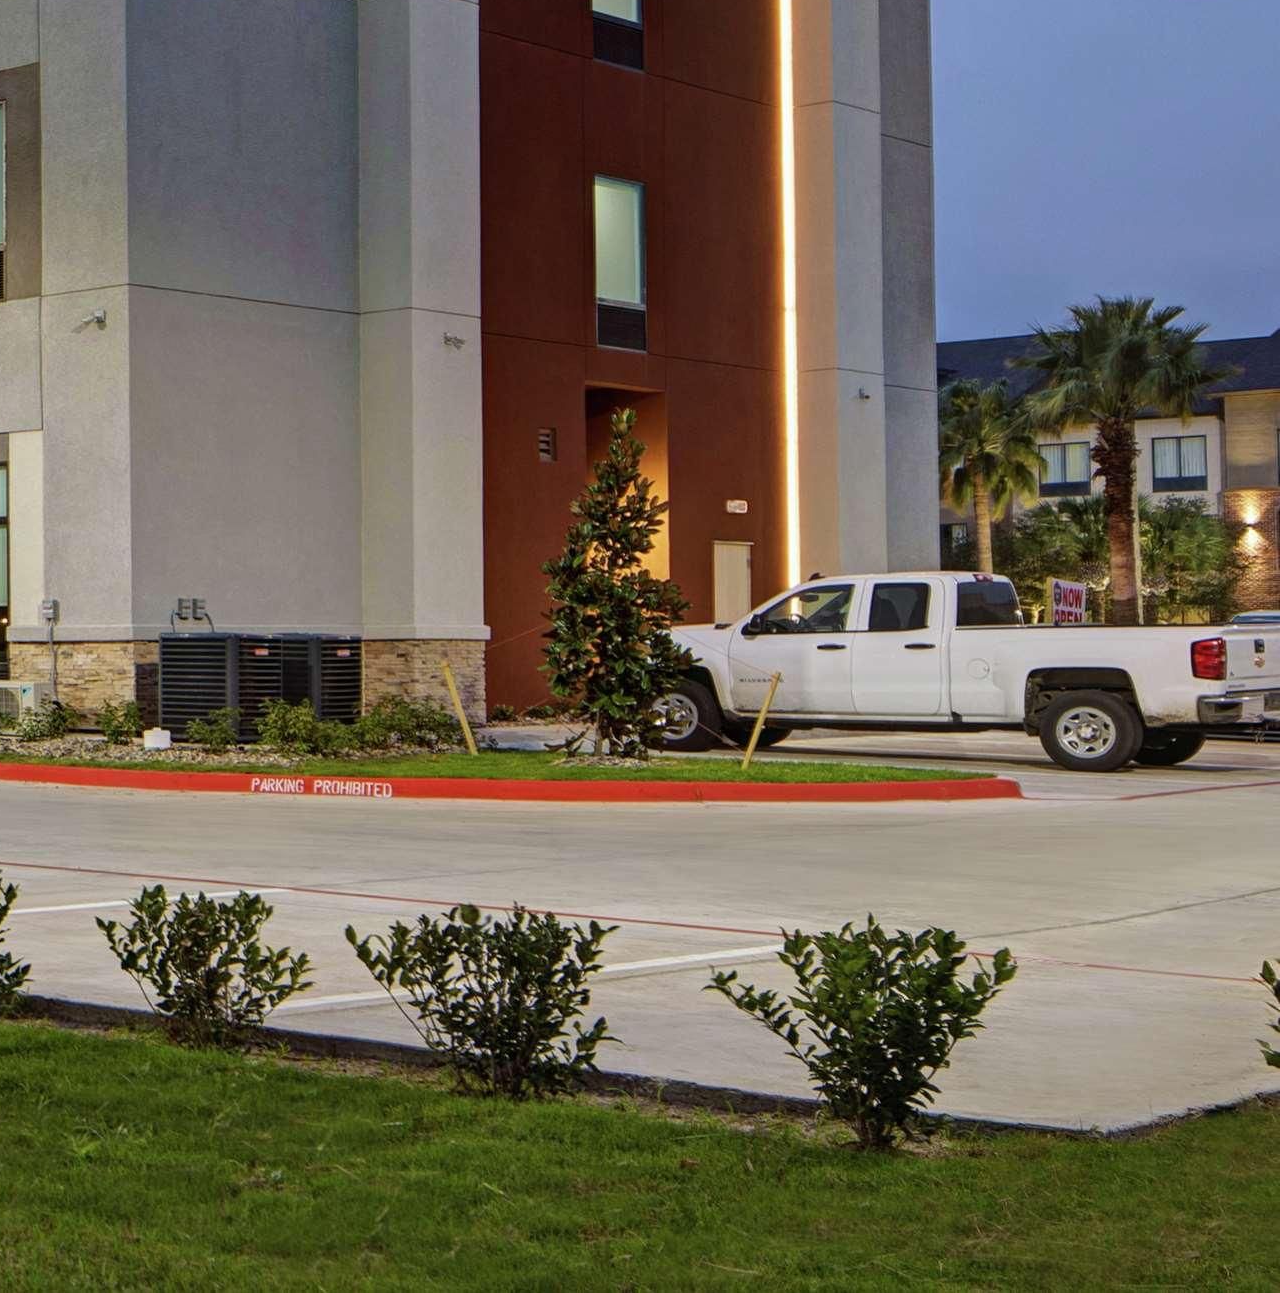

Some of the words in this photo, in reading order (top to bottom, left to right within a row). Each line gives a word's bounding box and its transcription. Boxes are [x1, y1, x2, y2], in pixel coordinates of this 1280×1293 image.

[1062, 586, 1083, 608] NOW
[251, 777, 304, 794] PARKING
[313, 779, 393, 798] PROHIBITED
